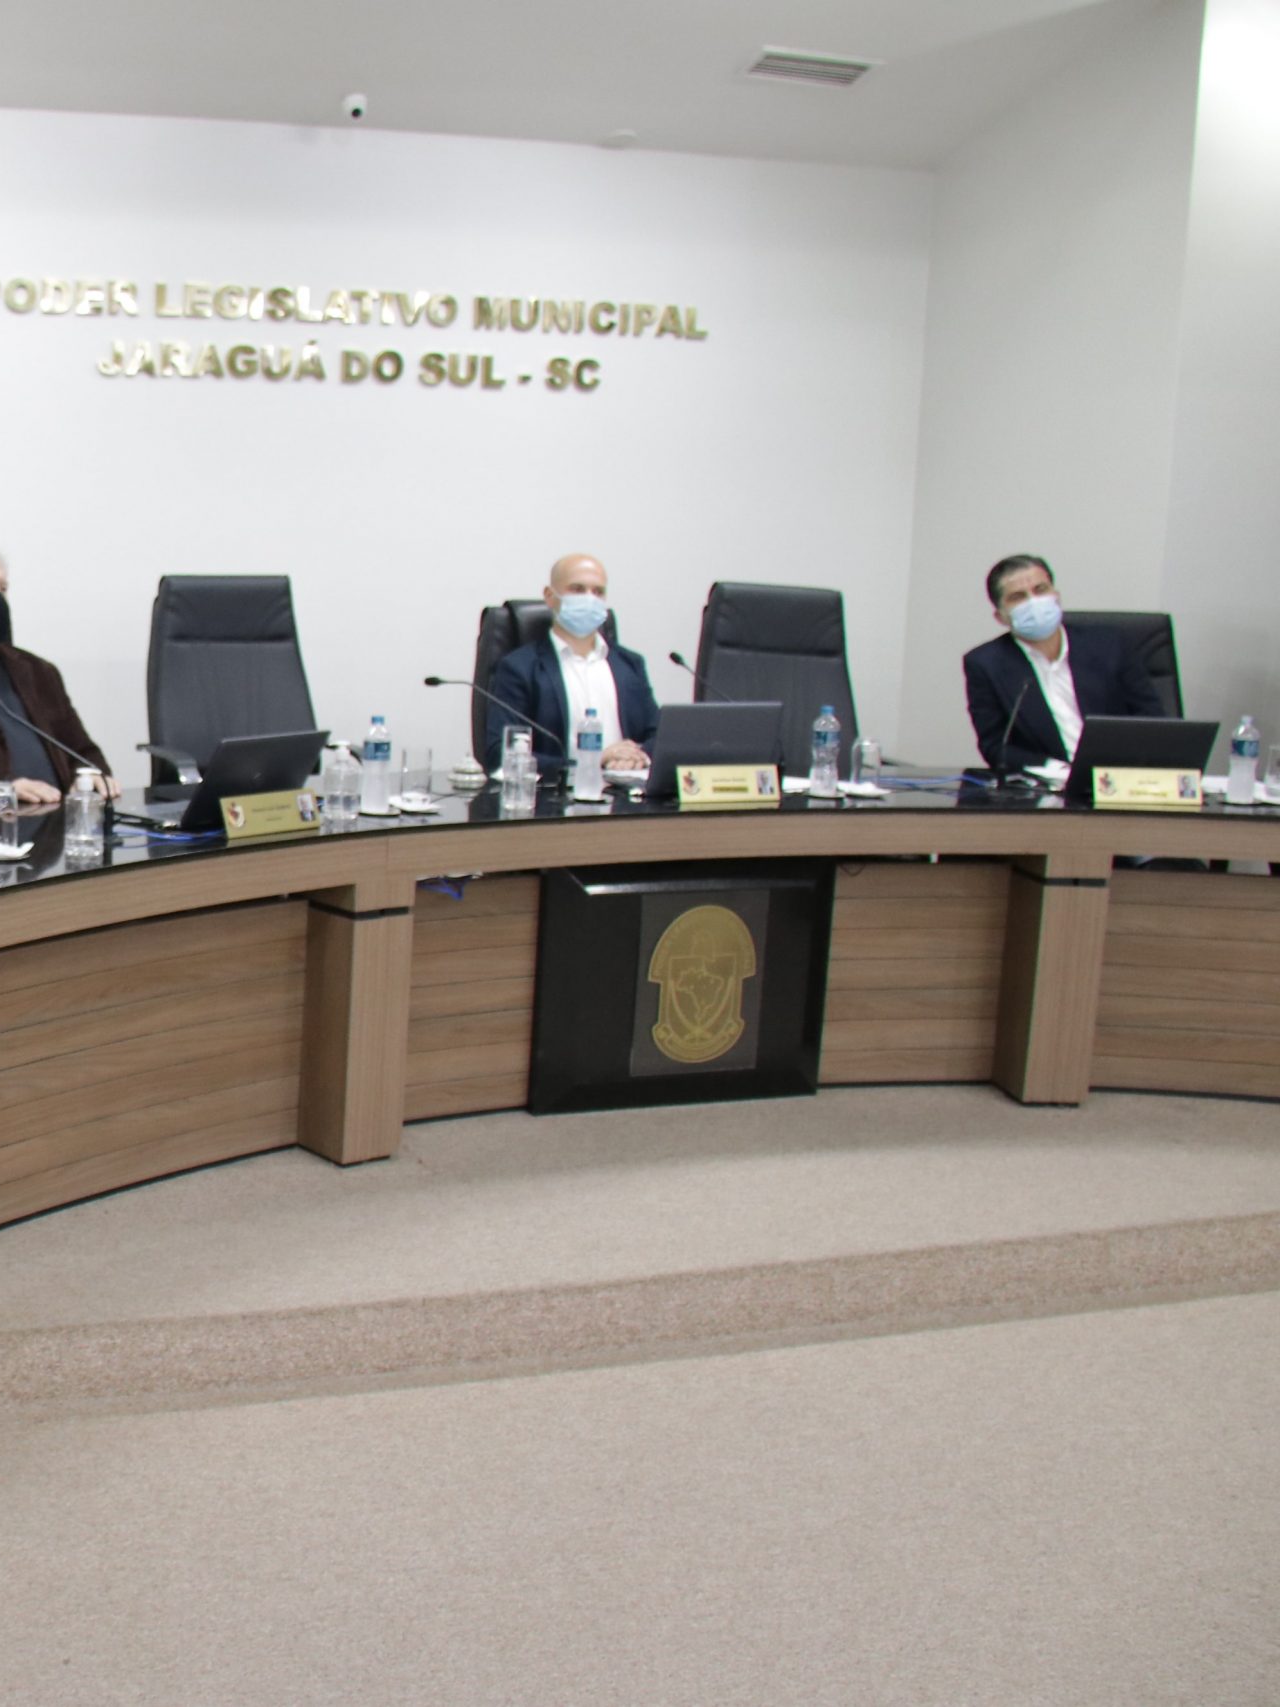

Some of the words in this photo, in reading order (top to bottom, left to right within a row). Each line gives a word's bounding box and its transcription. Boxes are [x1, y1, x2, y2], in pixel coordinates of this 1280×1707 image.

[154, 282, 457, 327] LEGISLATIVO
[472, 296, 708, 340] MUNICIPAL
[97, 340, 325, 382] JARAGUÁ
[341, 349, 404, 383] DO
[419, 352, 506, 389] SUL
[545, 357, 600, 391] SC
